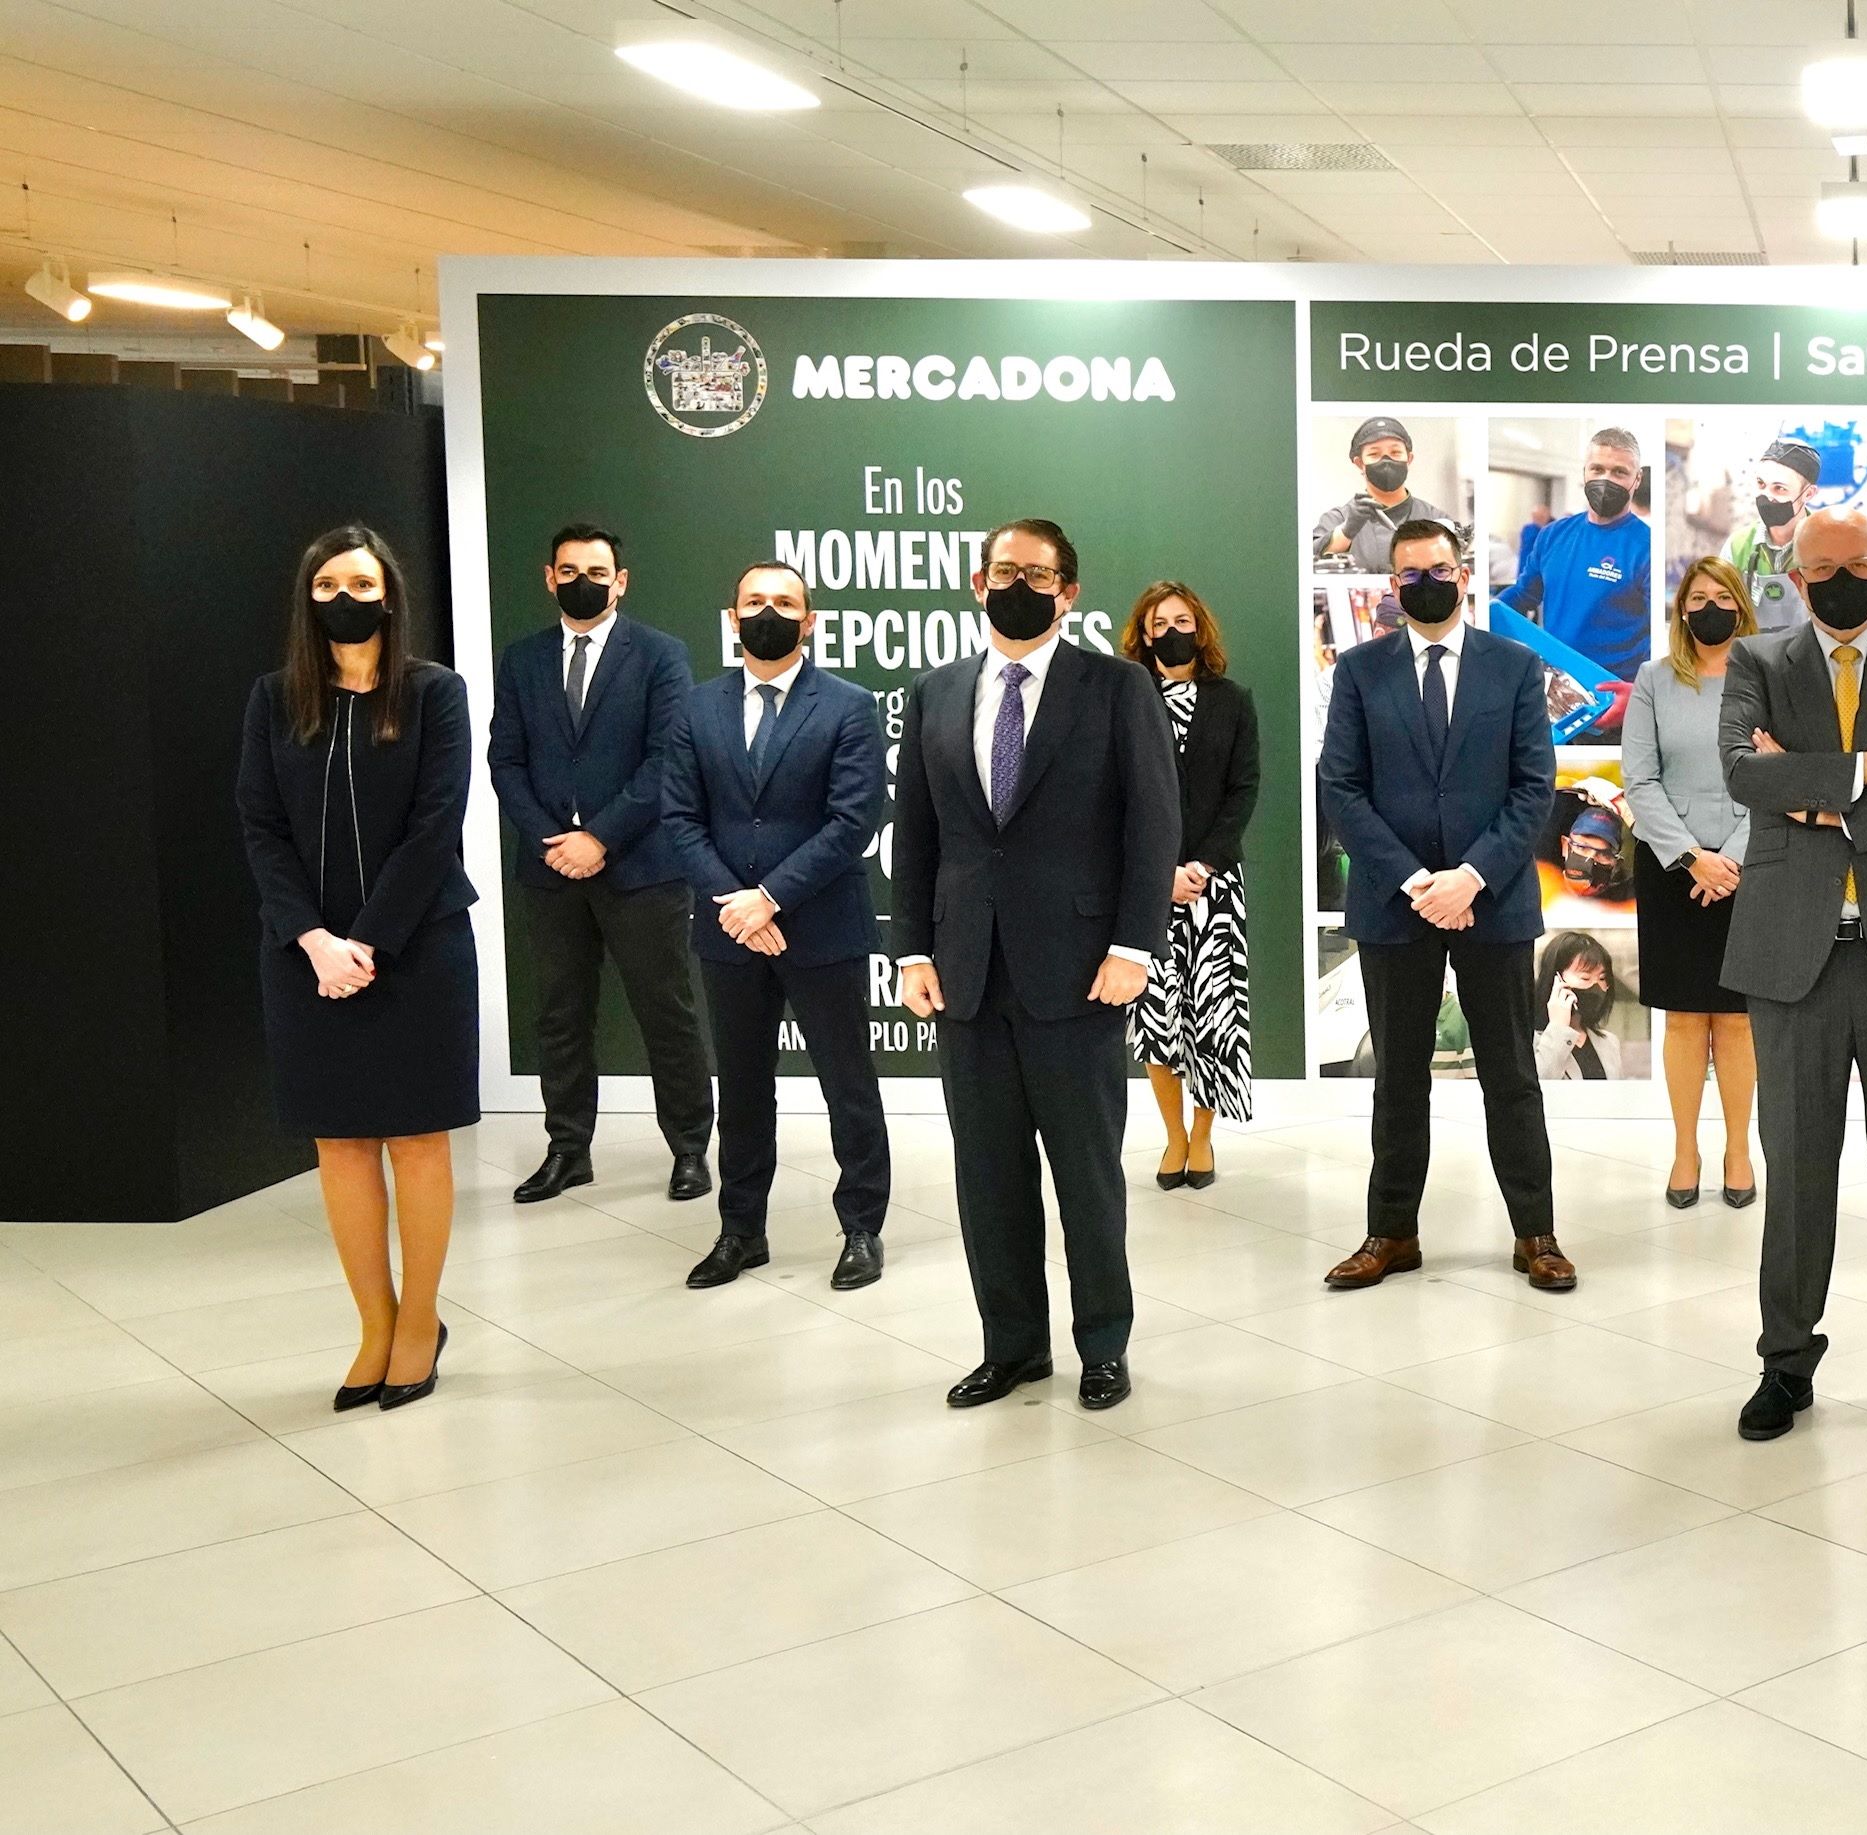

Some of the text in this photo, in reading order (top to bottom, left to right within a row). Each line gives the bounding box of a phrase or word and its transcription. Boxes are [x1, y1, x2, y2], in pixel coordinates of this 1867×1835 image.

[791, 353, 1177, 403] MERCADONA
[1339, 332, 1492, 372] Rueda
[1510, 333, 1570, 373] de
[1589, 334, 1750, 374] Prensa
[864, 465, 965, 516] En los
[774, 529, 989, 591] MOMENT
[777, 1020, 807, 1051] AN
[916, 1021, 938, 1052] PA
